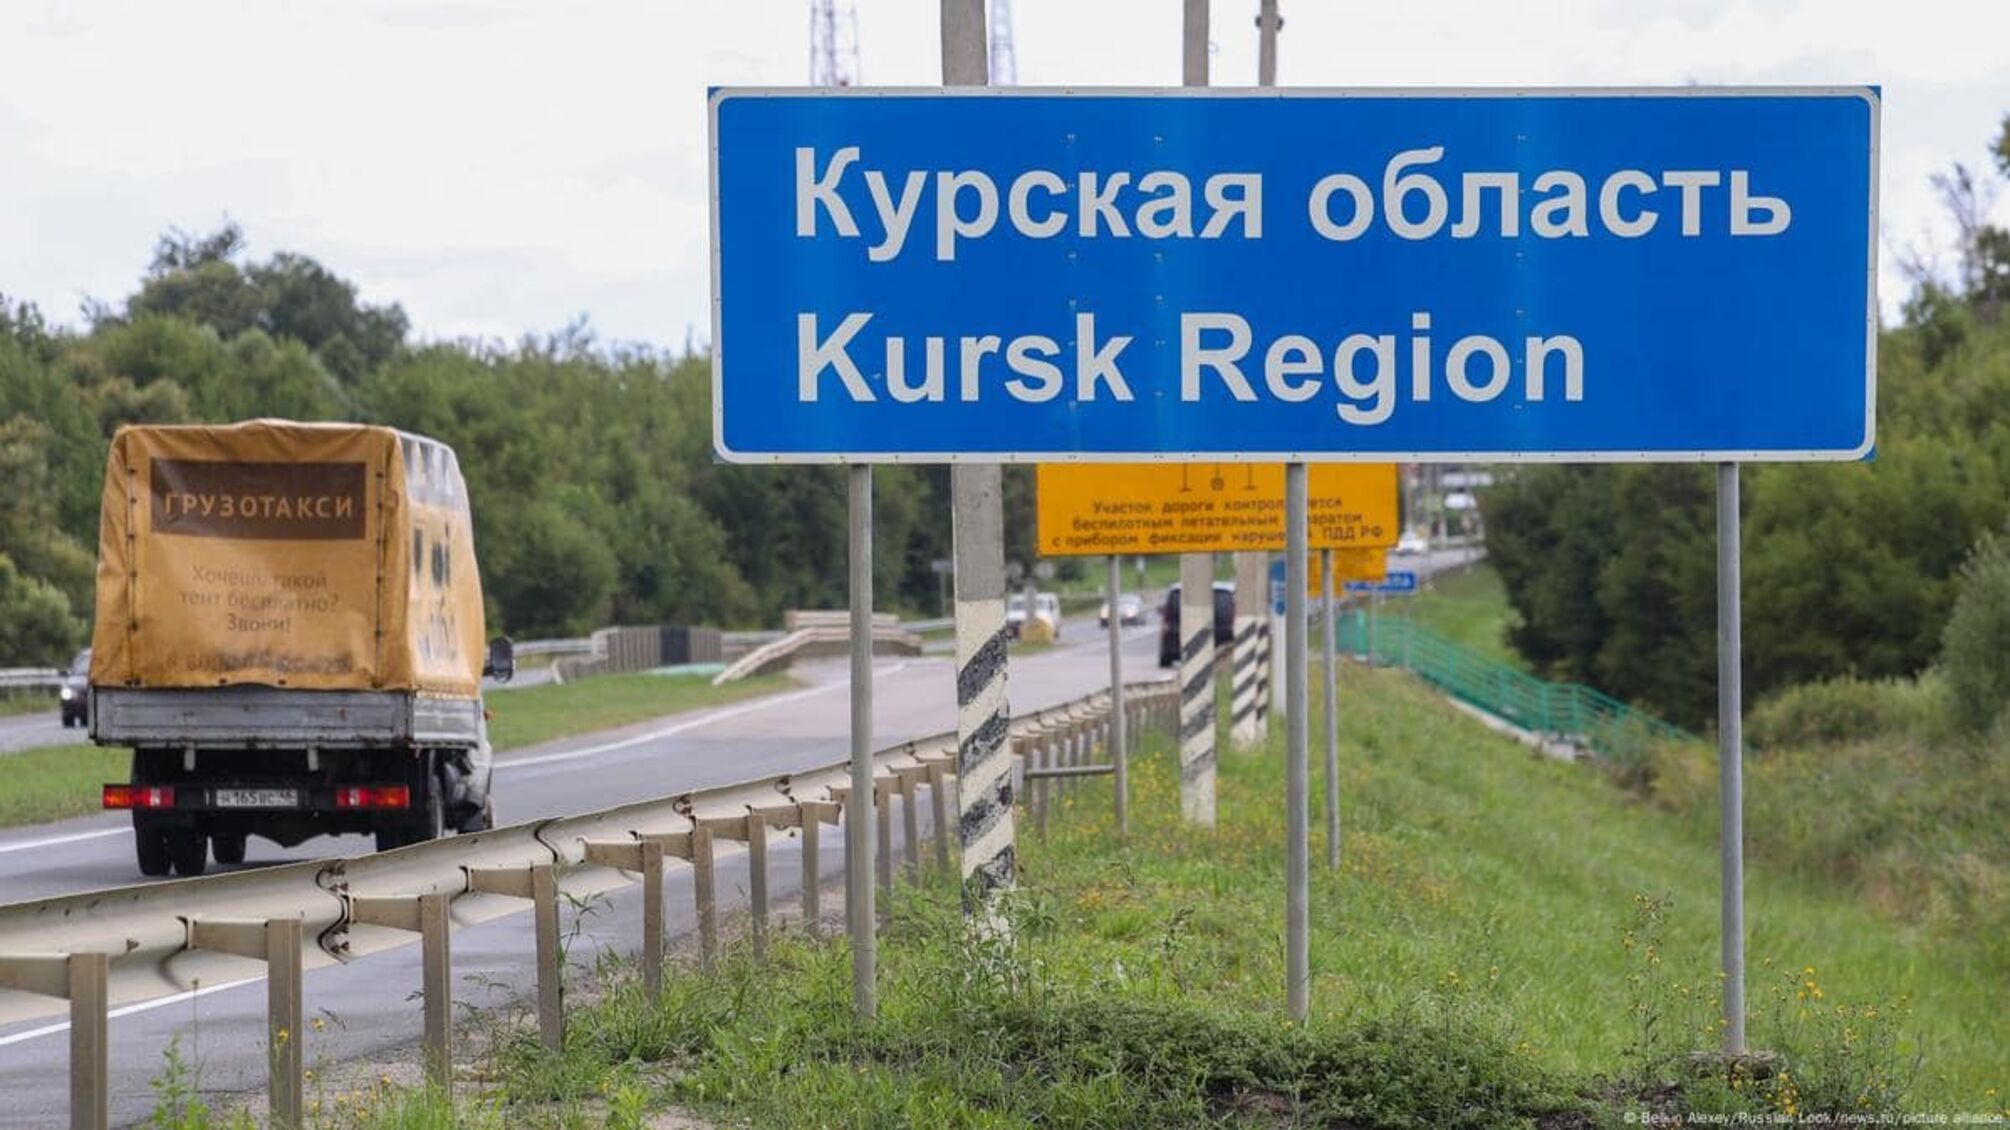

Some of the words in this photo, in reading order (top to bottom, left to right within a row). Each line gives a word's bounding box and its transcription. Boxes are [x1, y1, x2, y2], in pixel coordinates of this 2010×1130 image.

[796, 146, 1263, 260] Курская
[1309, 146, 1791, 240] область
[798, 313, 1134, 402] Kursk
[1181, 312, 1583, 425] Region
[164, 492, 353, 518] ГРУЗОТАКСИ
[1162, 501, 1214, 514] дороги
[1225, 498, 1342, 512] контролется
[1322, 526, 1355, 541] ПДД
[1360, 525, 1383, 539] РФ
